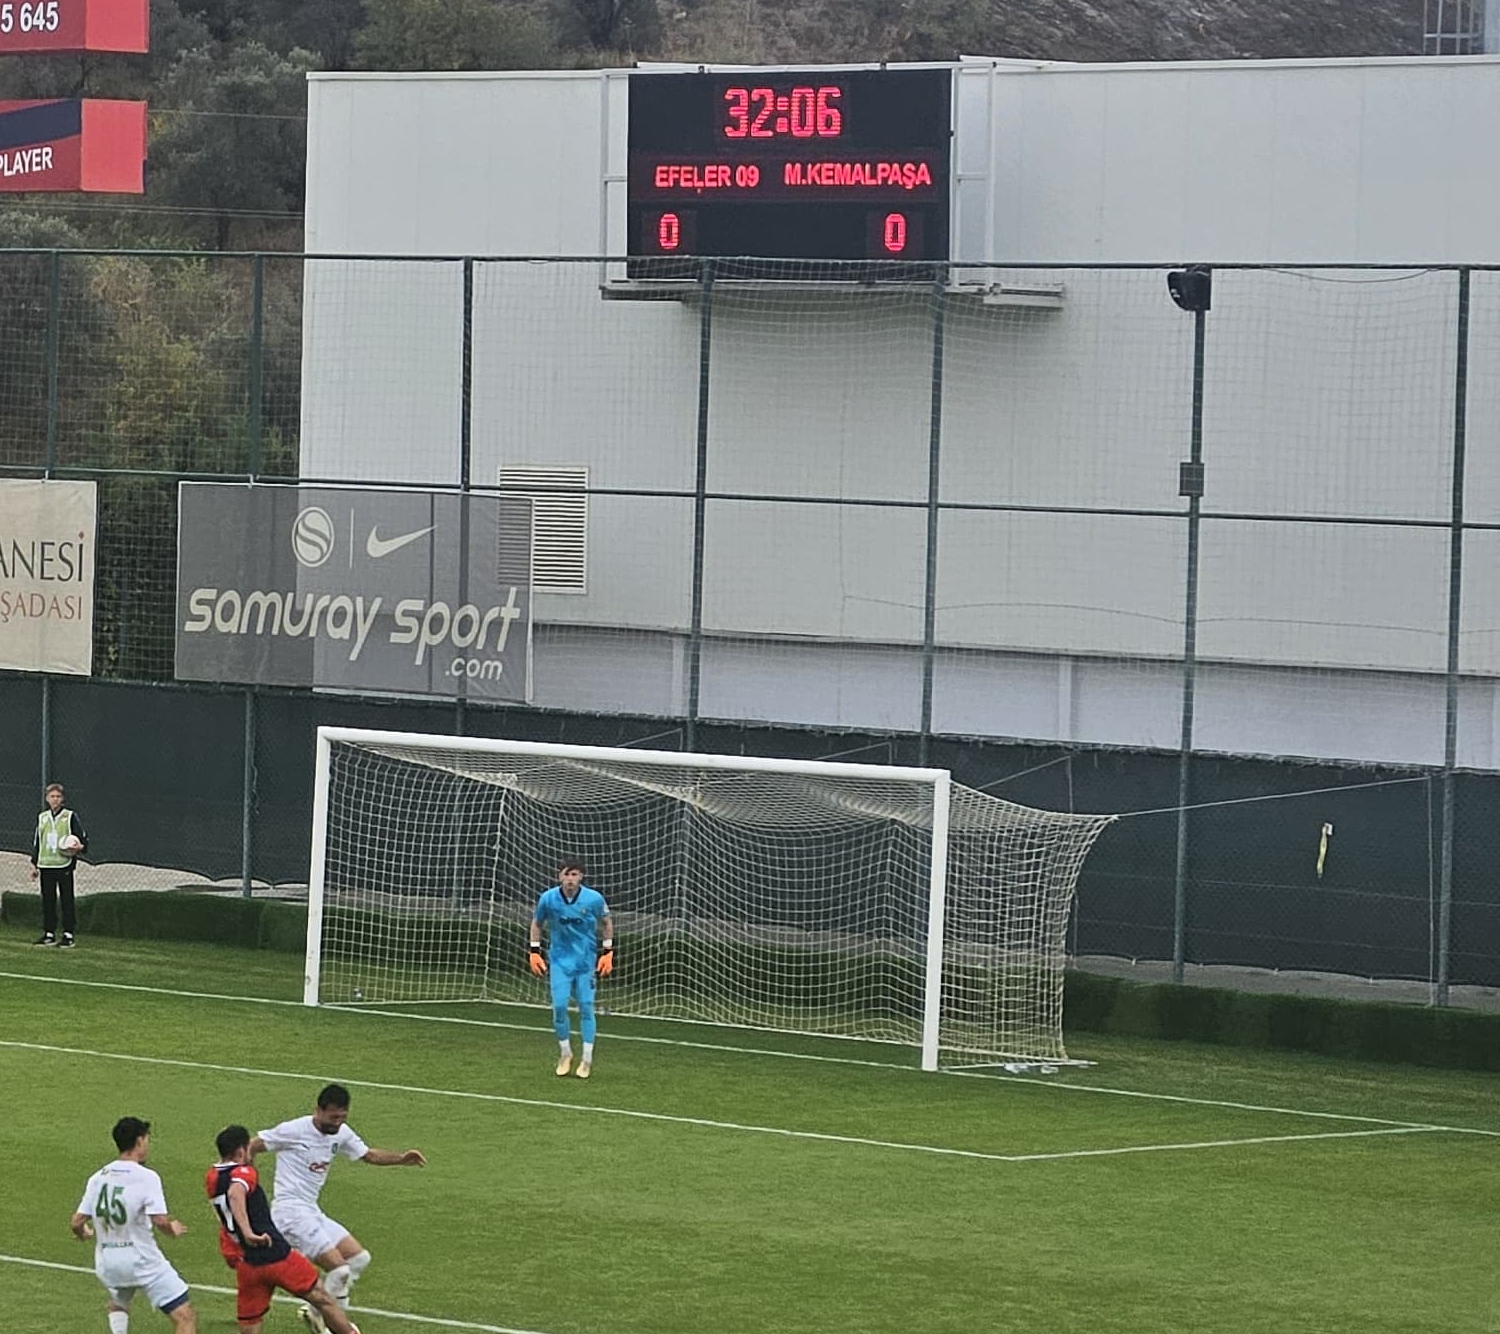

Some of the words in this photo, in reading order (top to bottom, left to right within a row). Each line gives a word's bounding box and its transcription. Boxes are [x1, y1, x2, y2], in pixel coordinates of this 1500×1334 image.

[0, 2, 14, 33] 5
[20, 0, 60, 31] 645
[723, 86, 842, 138] 32:06
[655, 165, 732, 188] EFELER
[736, 165, 760, 187] 09
[784, 163, 932, 190] M.KEMALPAŞA
[659, 213, 680, 250] 0
[884, 213, 907, 252] 0
[184, 588, 382, 661] samuray
[390, 586, 521, 666] sport
[445, 657, 504, 681] .com
[96, 1182, 128, 1226] 45
